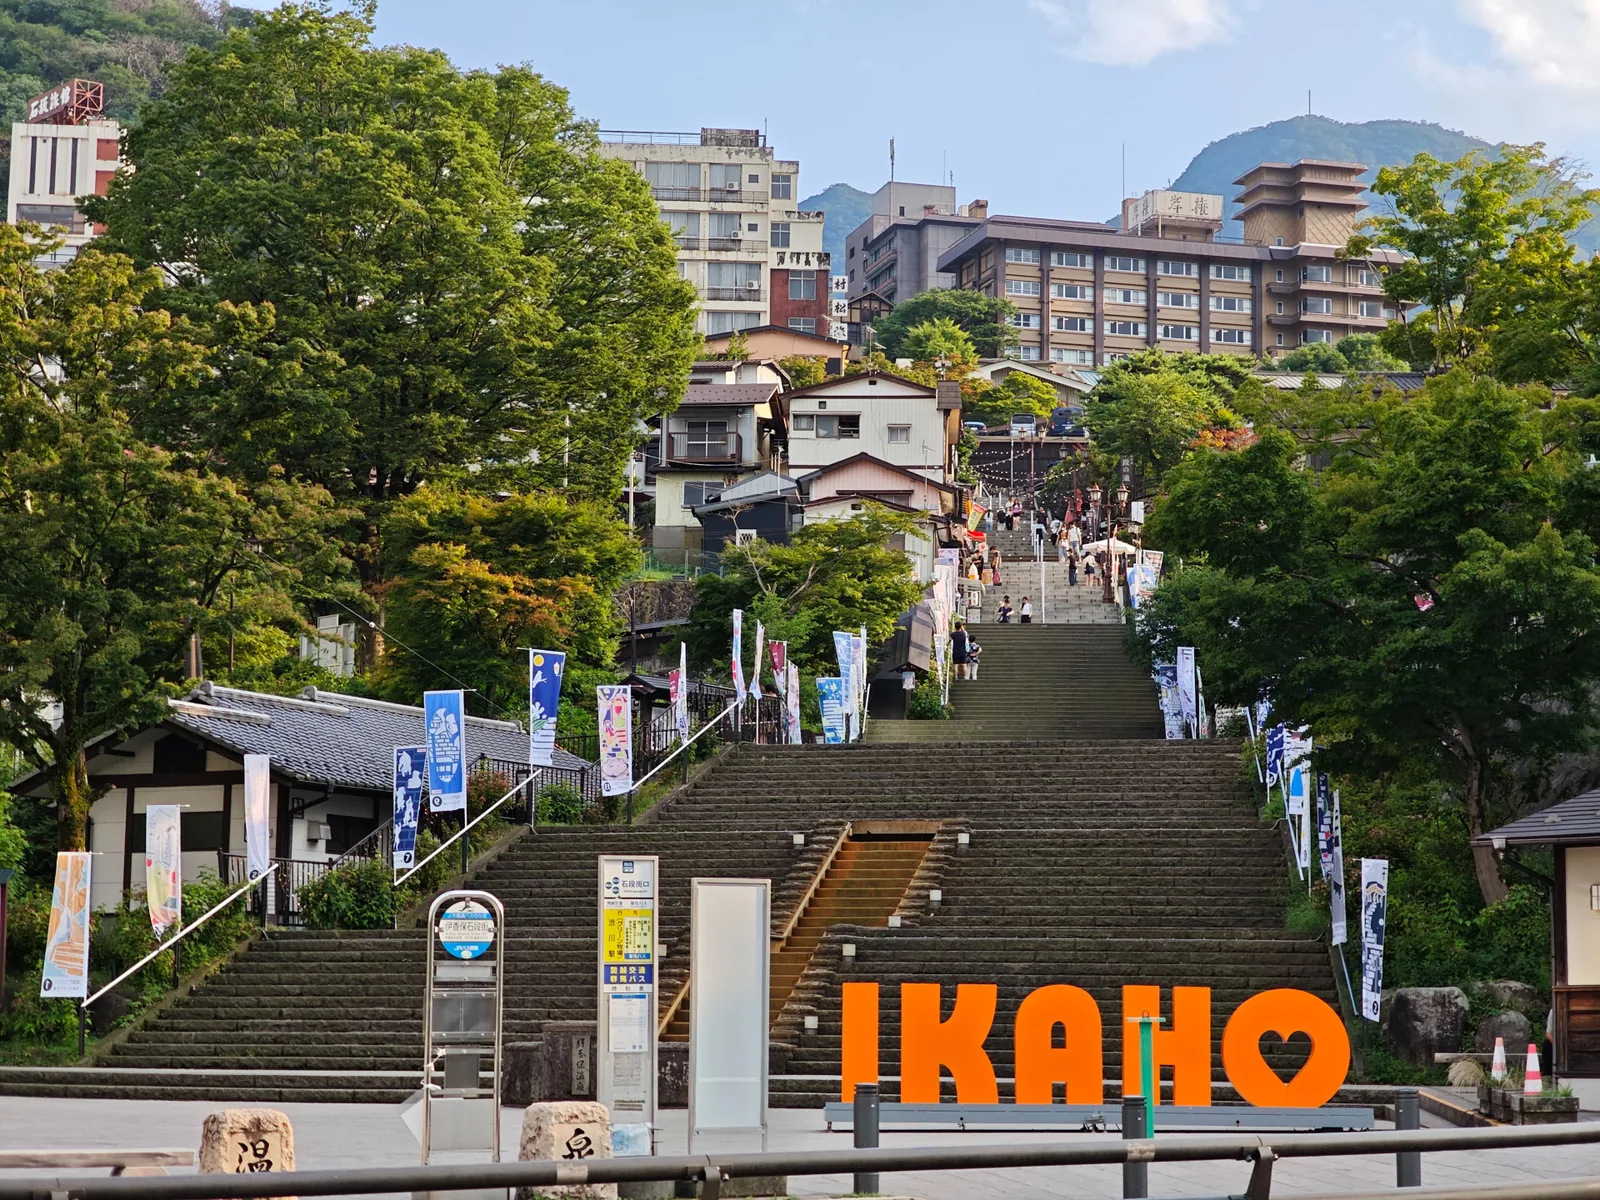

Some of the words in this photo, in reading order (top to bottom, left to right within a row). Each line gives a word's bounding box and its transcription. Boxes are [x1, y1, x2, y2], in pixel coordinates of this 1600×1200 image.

[445, 921, 489, 931] 伊香保石段街
[608, 918, 616, 958] 渋川駅
[610, 975, 646, 983] 群馬バス
[842, 982, 1351, 1108] IKAHO
[236, 1138, 272, 1173] 温
[561, 1127, 595, 1160] 泉
